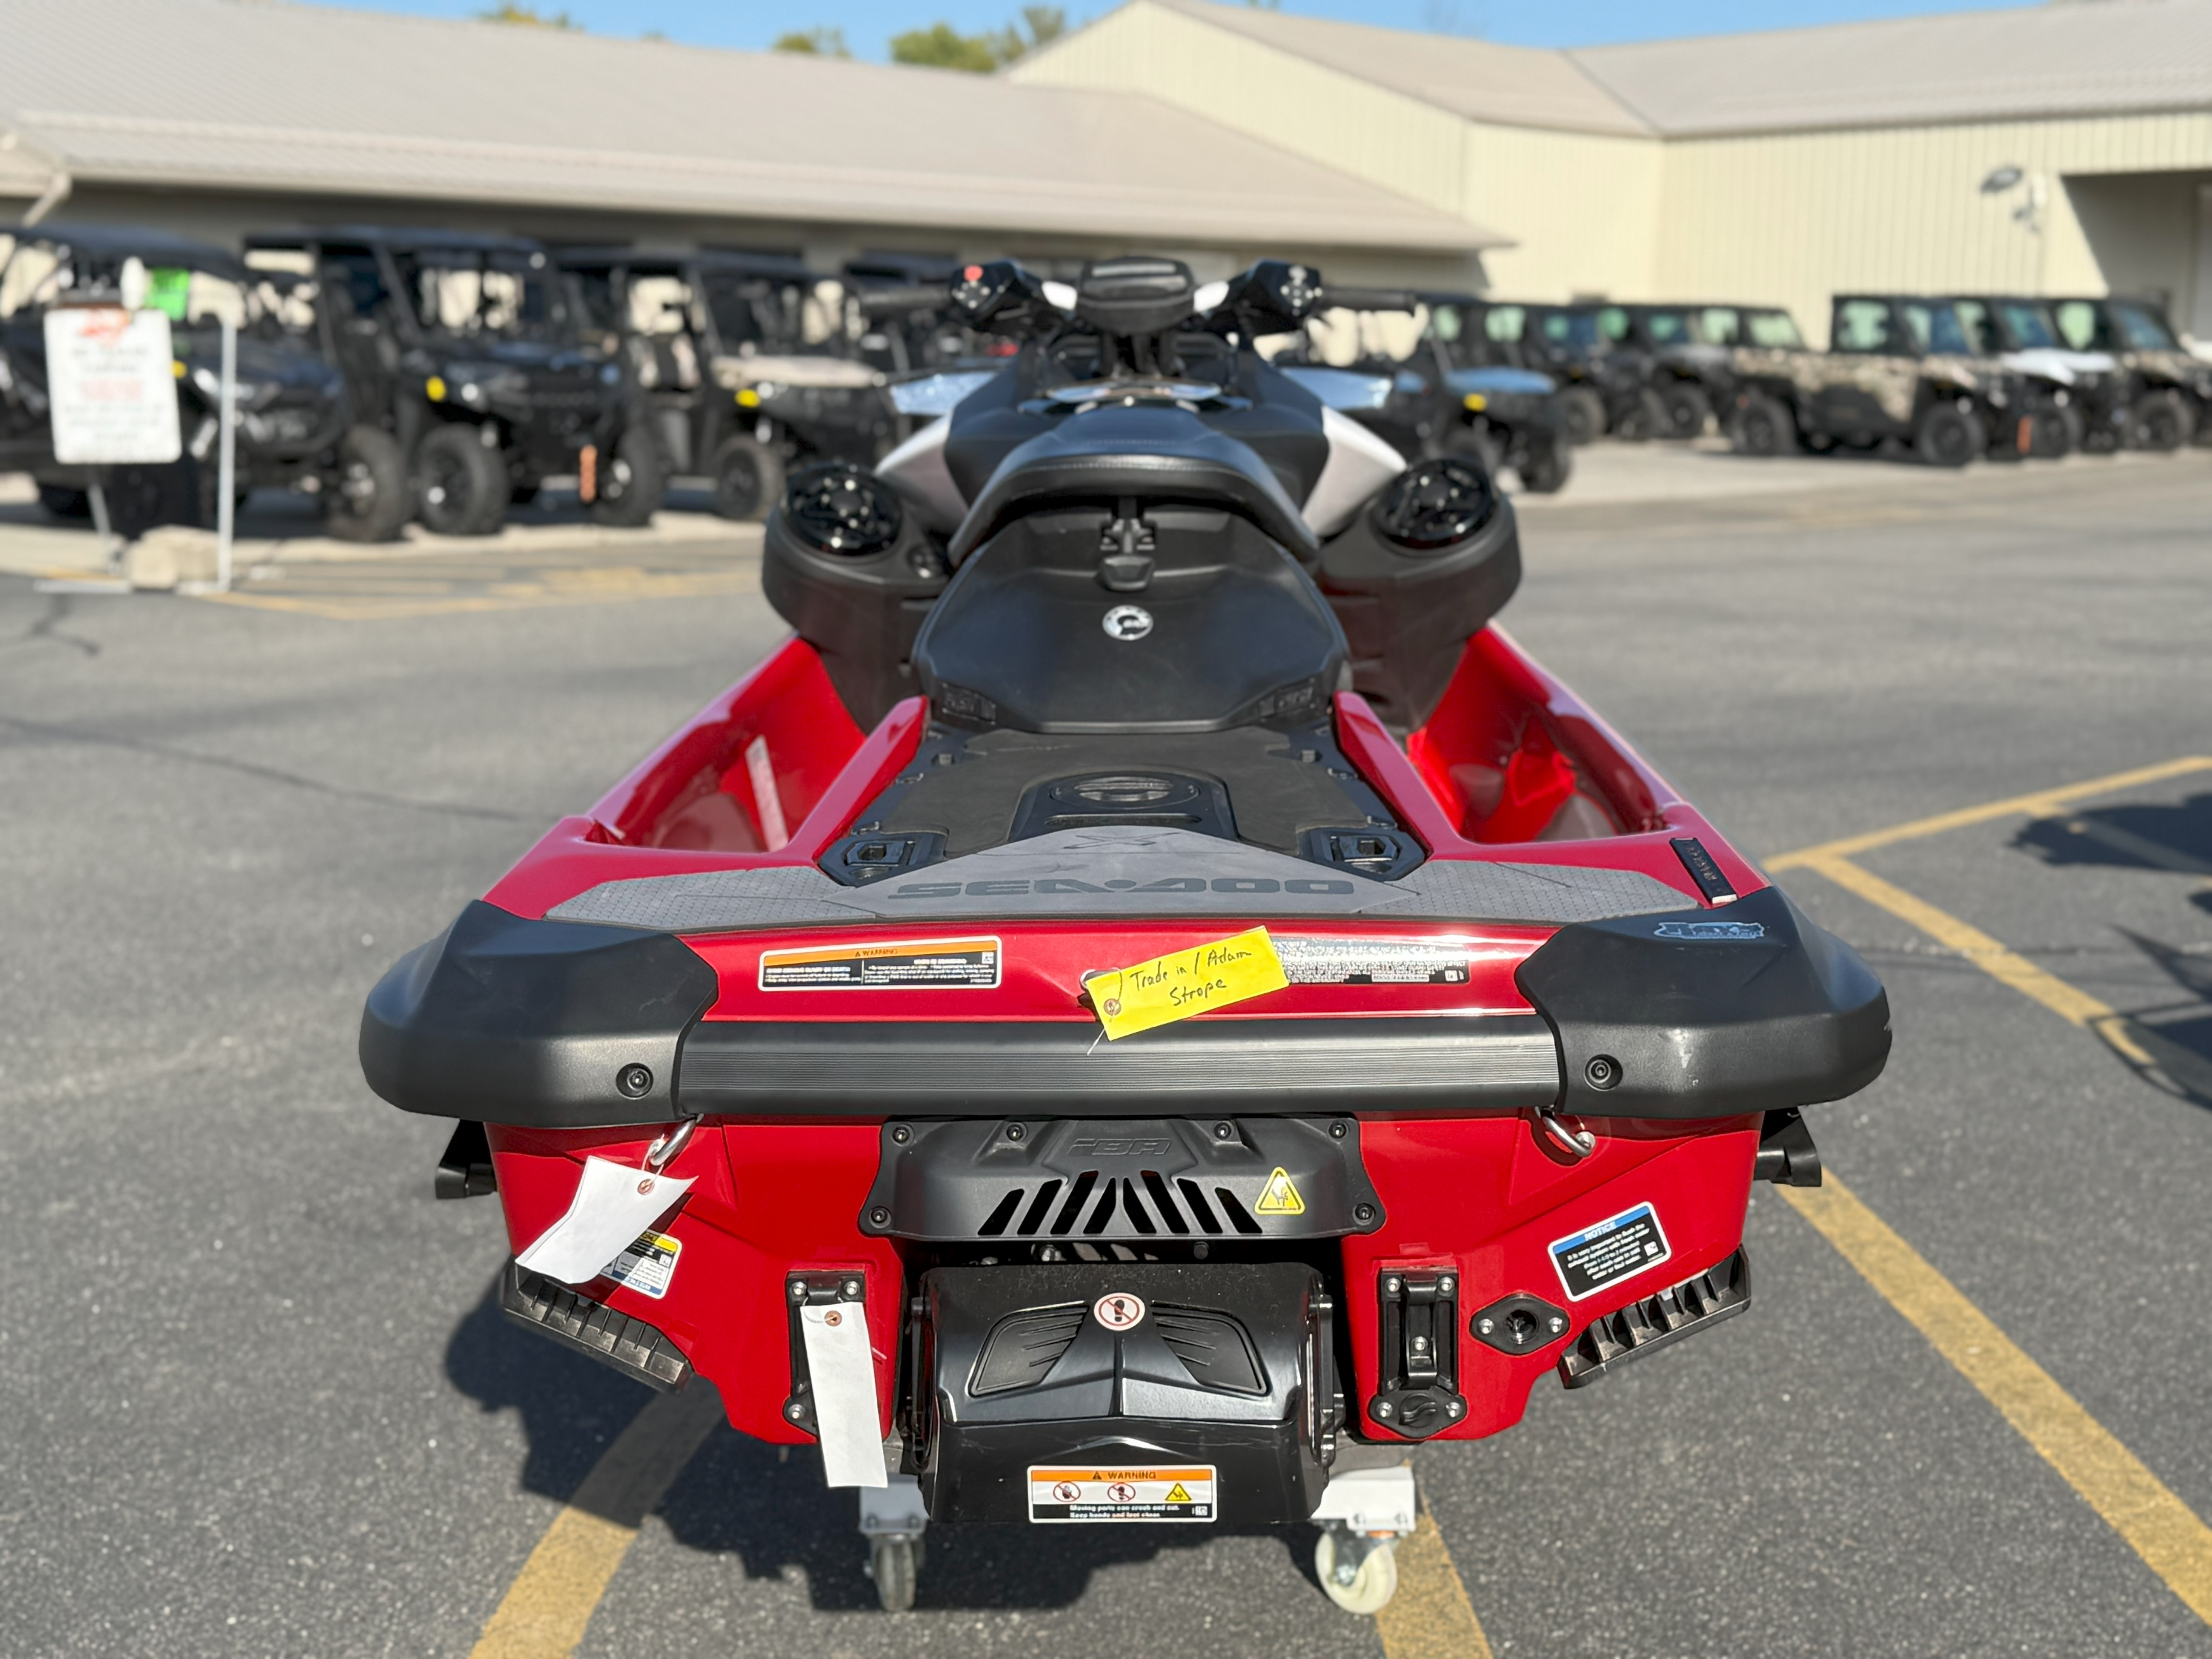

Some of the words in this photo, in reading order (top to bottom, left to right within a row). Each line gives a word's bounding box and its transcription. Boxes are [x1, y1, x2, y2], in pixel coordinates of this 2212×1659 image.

[1130, 960, 1168, 992] Trade
[1176, 966, 1187, 975] in
[1207, 947, 1252, 967] Adam
[1170, 979, 1227, 1006] Strope
[1584, 1221, 1617, 1241] NOTICE
[1108, 1470, 1156, 1479] WARNING
